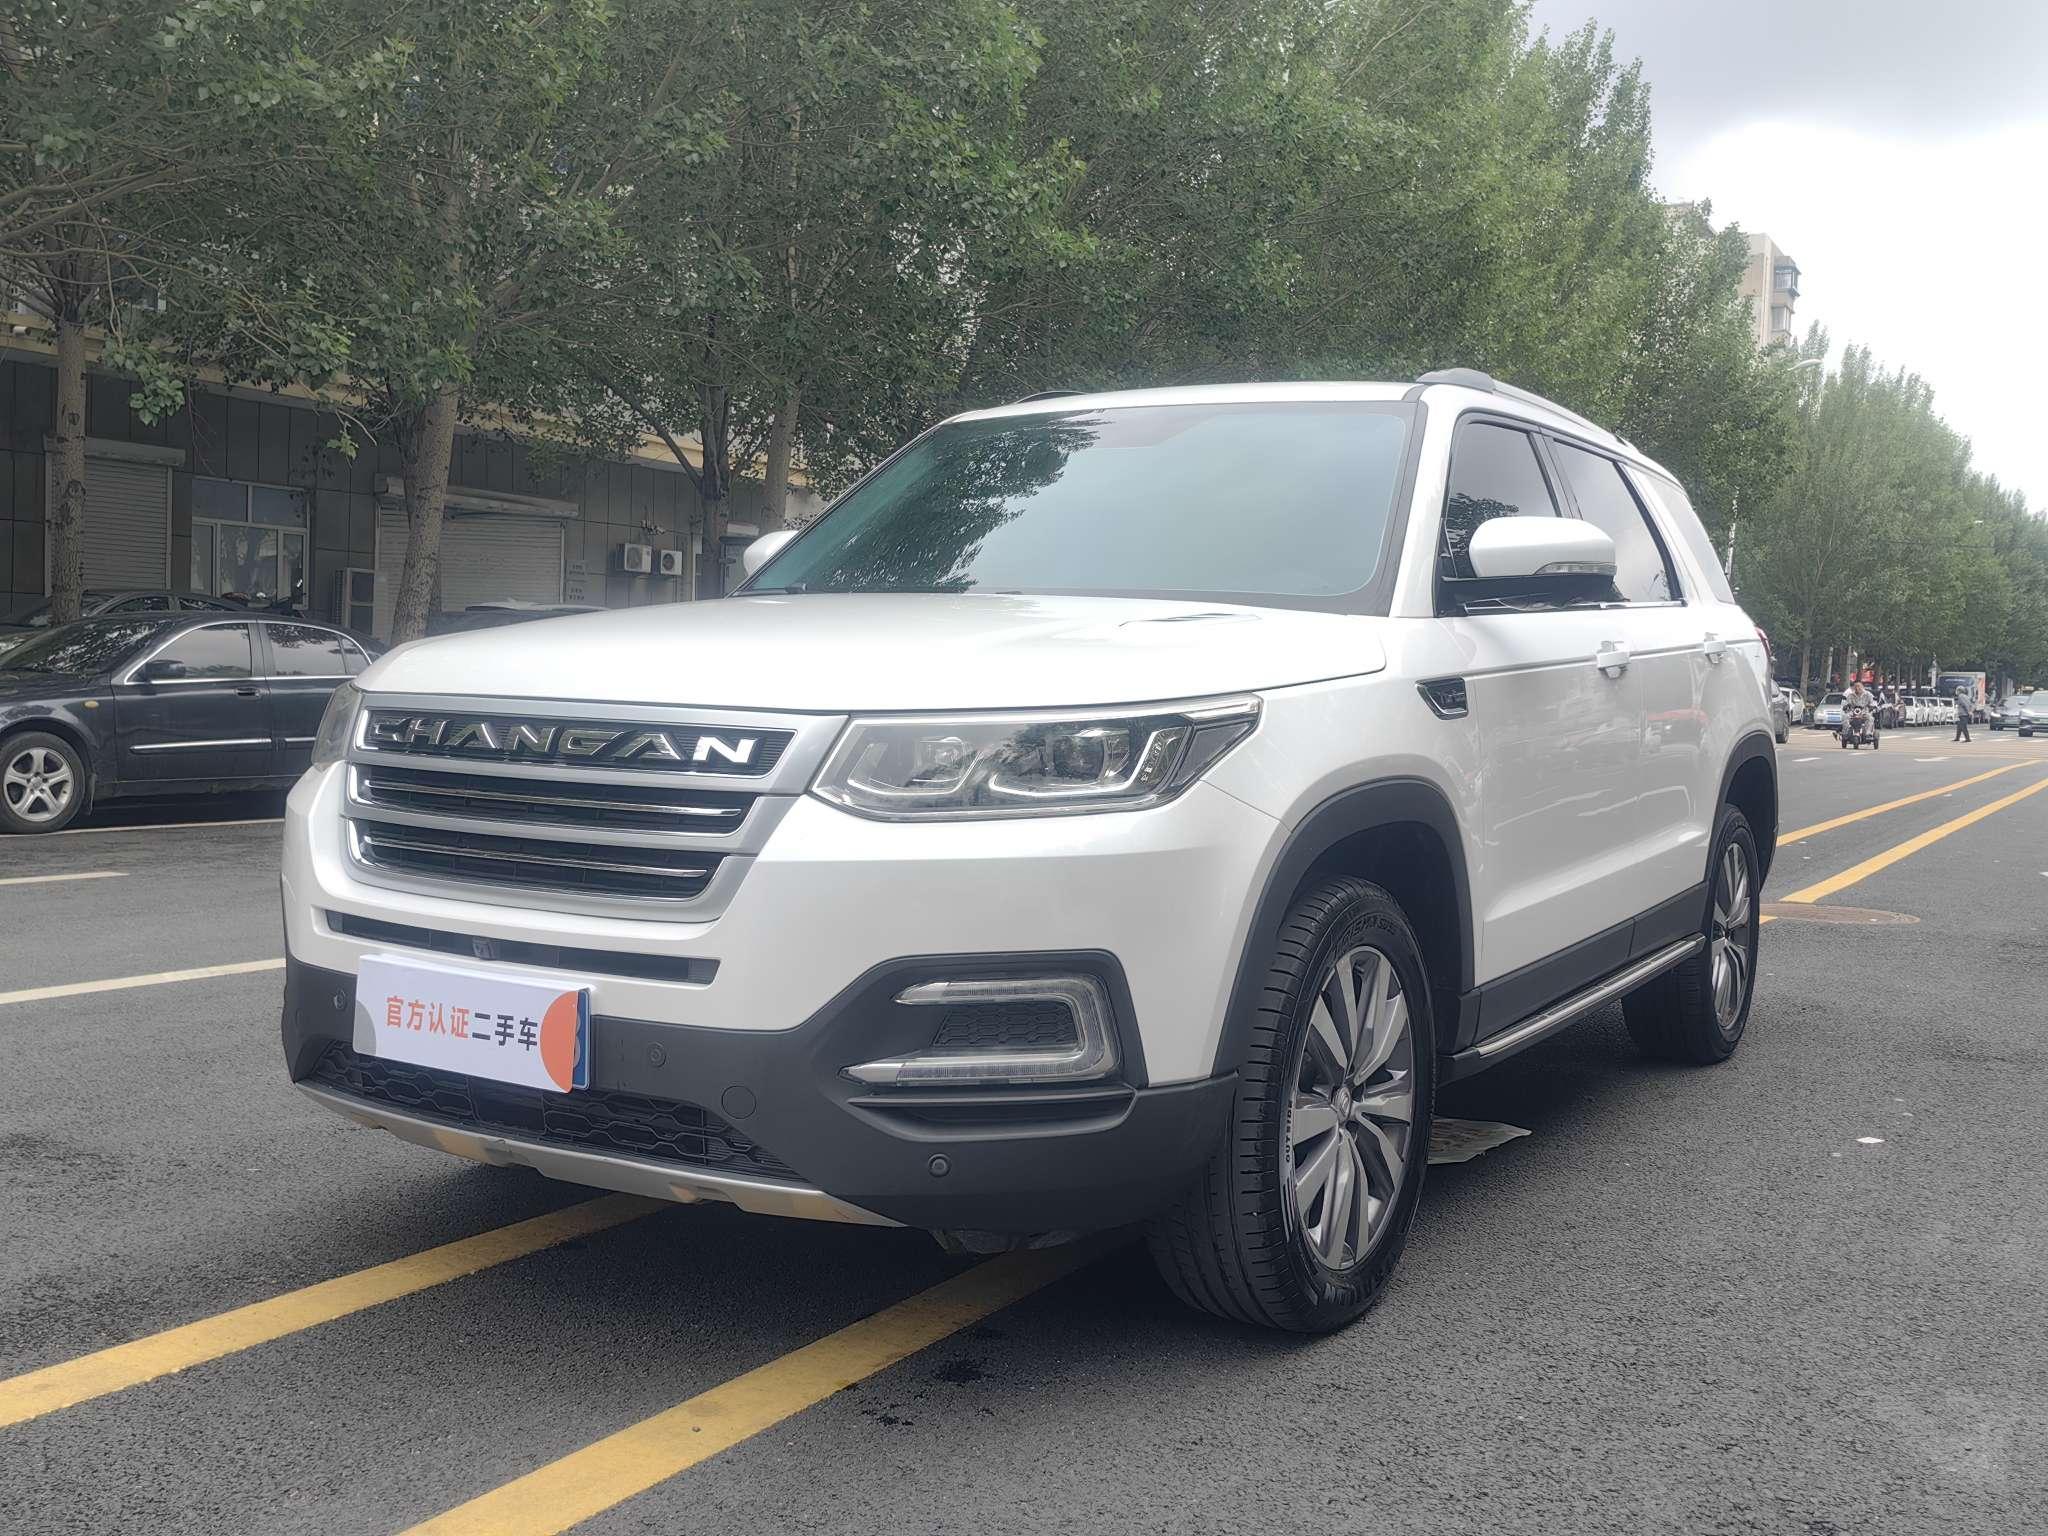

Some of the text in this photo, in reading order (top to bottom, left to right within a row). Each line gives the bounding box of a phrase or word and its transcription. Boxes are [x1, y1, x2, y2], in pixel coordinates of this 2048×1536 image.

[373, 716, 760, 763] CHANGAN
[386, 996, 538, 1051] 官方认证二手车
